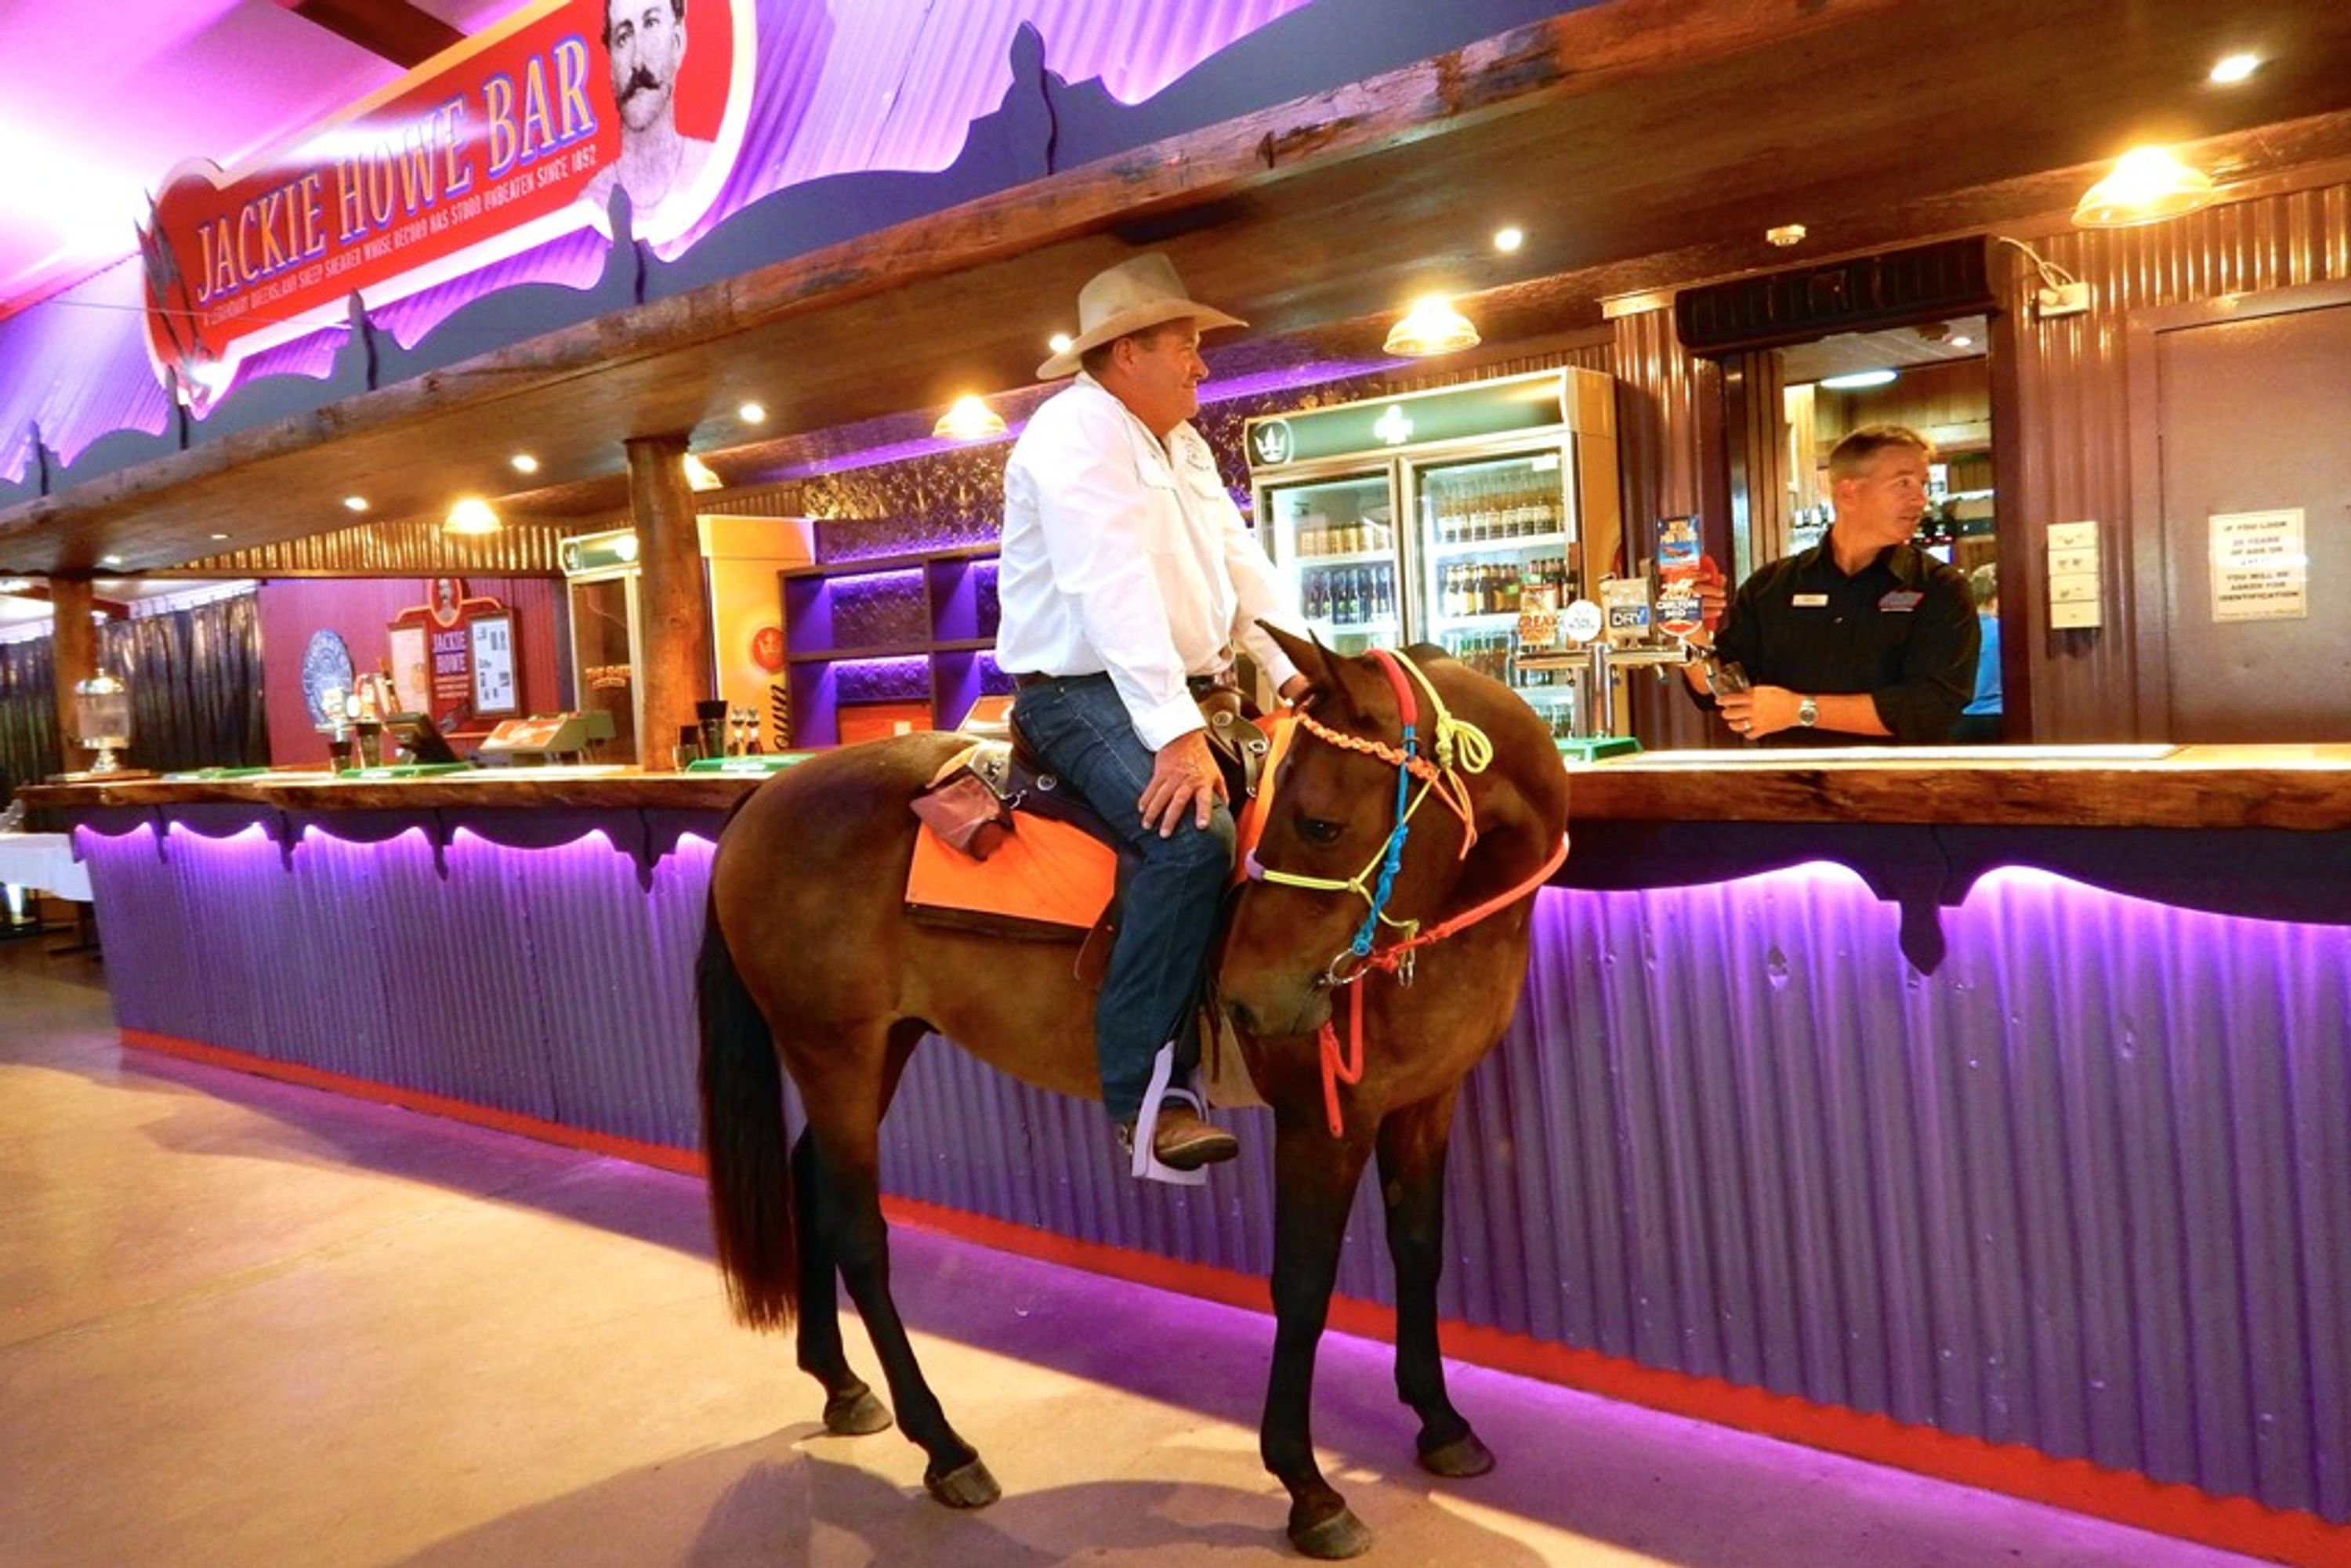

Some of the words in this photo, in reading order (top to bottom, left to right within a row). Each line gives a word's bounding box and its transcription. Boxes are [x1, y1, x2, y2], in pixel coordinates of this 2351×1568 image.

[196, 172, 326, 304] JACKIE
[335, 95, 472, 245] HOWE
[483, 35, 597, 179] BAR
[325, 247, 362, 277] SHEARER
[364, 234, 392, 260] WHOSE
[393, 219, 428, 249] RECORD
[430, 210, 448, 234] HAS
[451, 194, 482, 225] STOOD
[484, 172, 534, 210] UNBEATEN
[537, 156, 569, 188] SINCE
[433, 631, 467, 653] JACKIE
[1611, 611, 1642, 626] DRY
